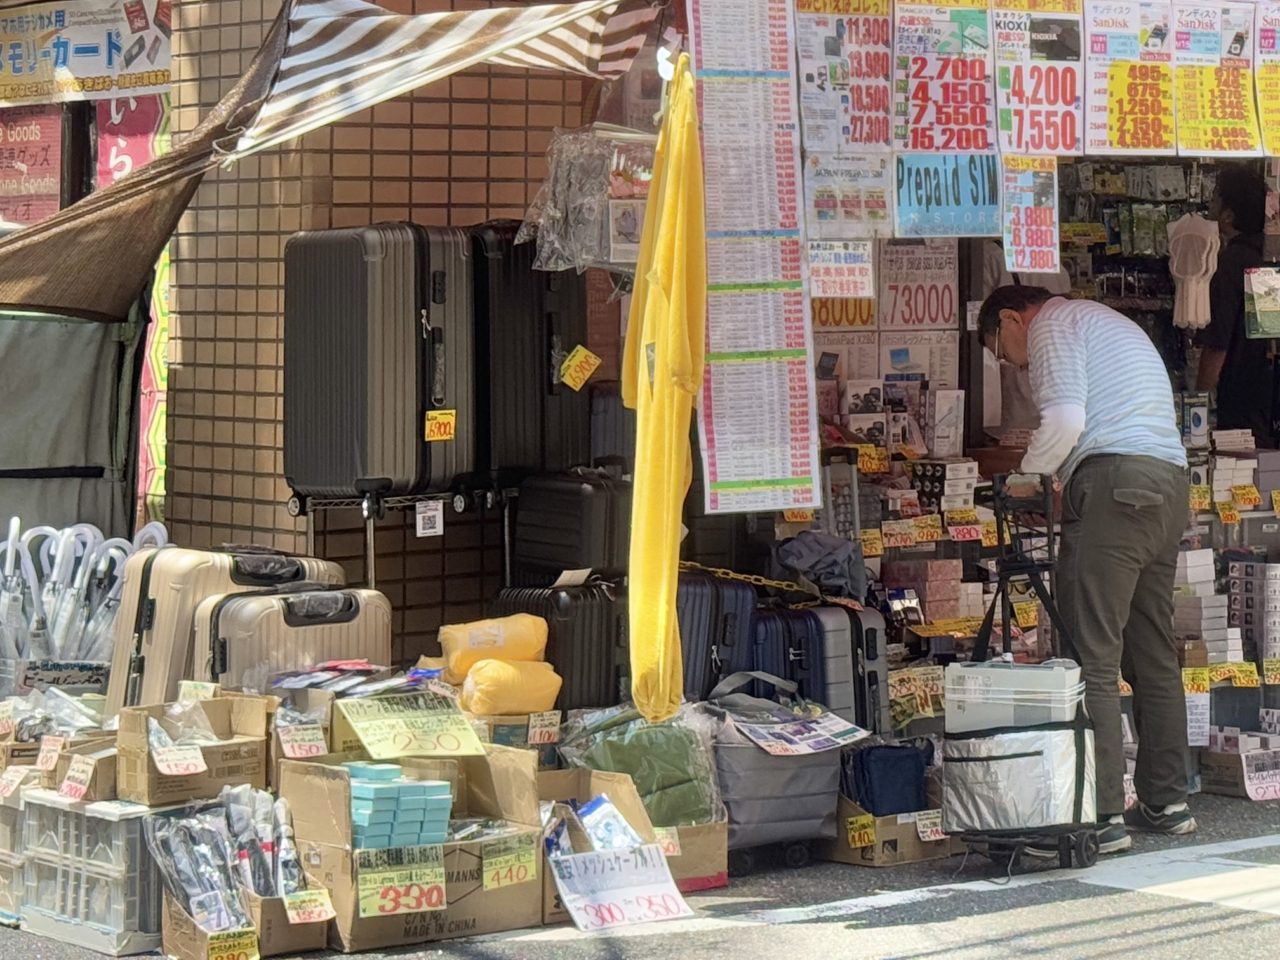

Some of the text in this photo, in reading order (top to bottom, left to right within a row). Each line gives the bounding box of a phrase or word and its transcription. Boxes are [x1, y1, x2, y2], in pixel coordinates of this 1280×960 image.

[1092, 18, 1129, 29] SanDisk
[1177, 19, 1216, 30] SanDisk
[1178, 8, 1217, 19] サンディスク
[995, 20, 1031, 31] KIOXI
[912, 56, 986, 81] 2,700
[1127, 64, 1162, 81] 495
[911, 81, 986, 105] 4,150
[1012, 65, 1077, 108] 4,200
[911, 104, 987, 127] 7,550
[1116, 99, 1162, 116] 1,250
[8, 121, 41, 142] Goods
[850, 115, 889, 145] 27,300
[910, 127, 988, 151] 15,200
[1013, 109, 1076, 153] 7,550
[896, 154, 998, 213] Prepaid SIM
[888, 284, 953, 326] 73,000
[403, 918, 477, 938] MADE IN CHINA
